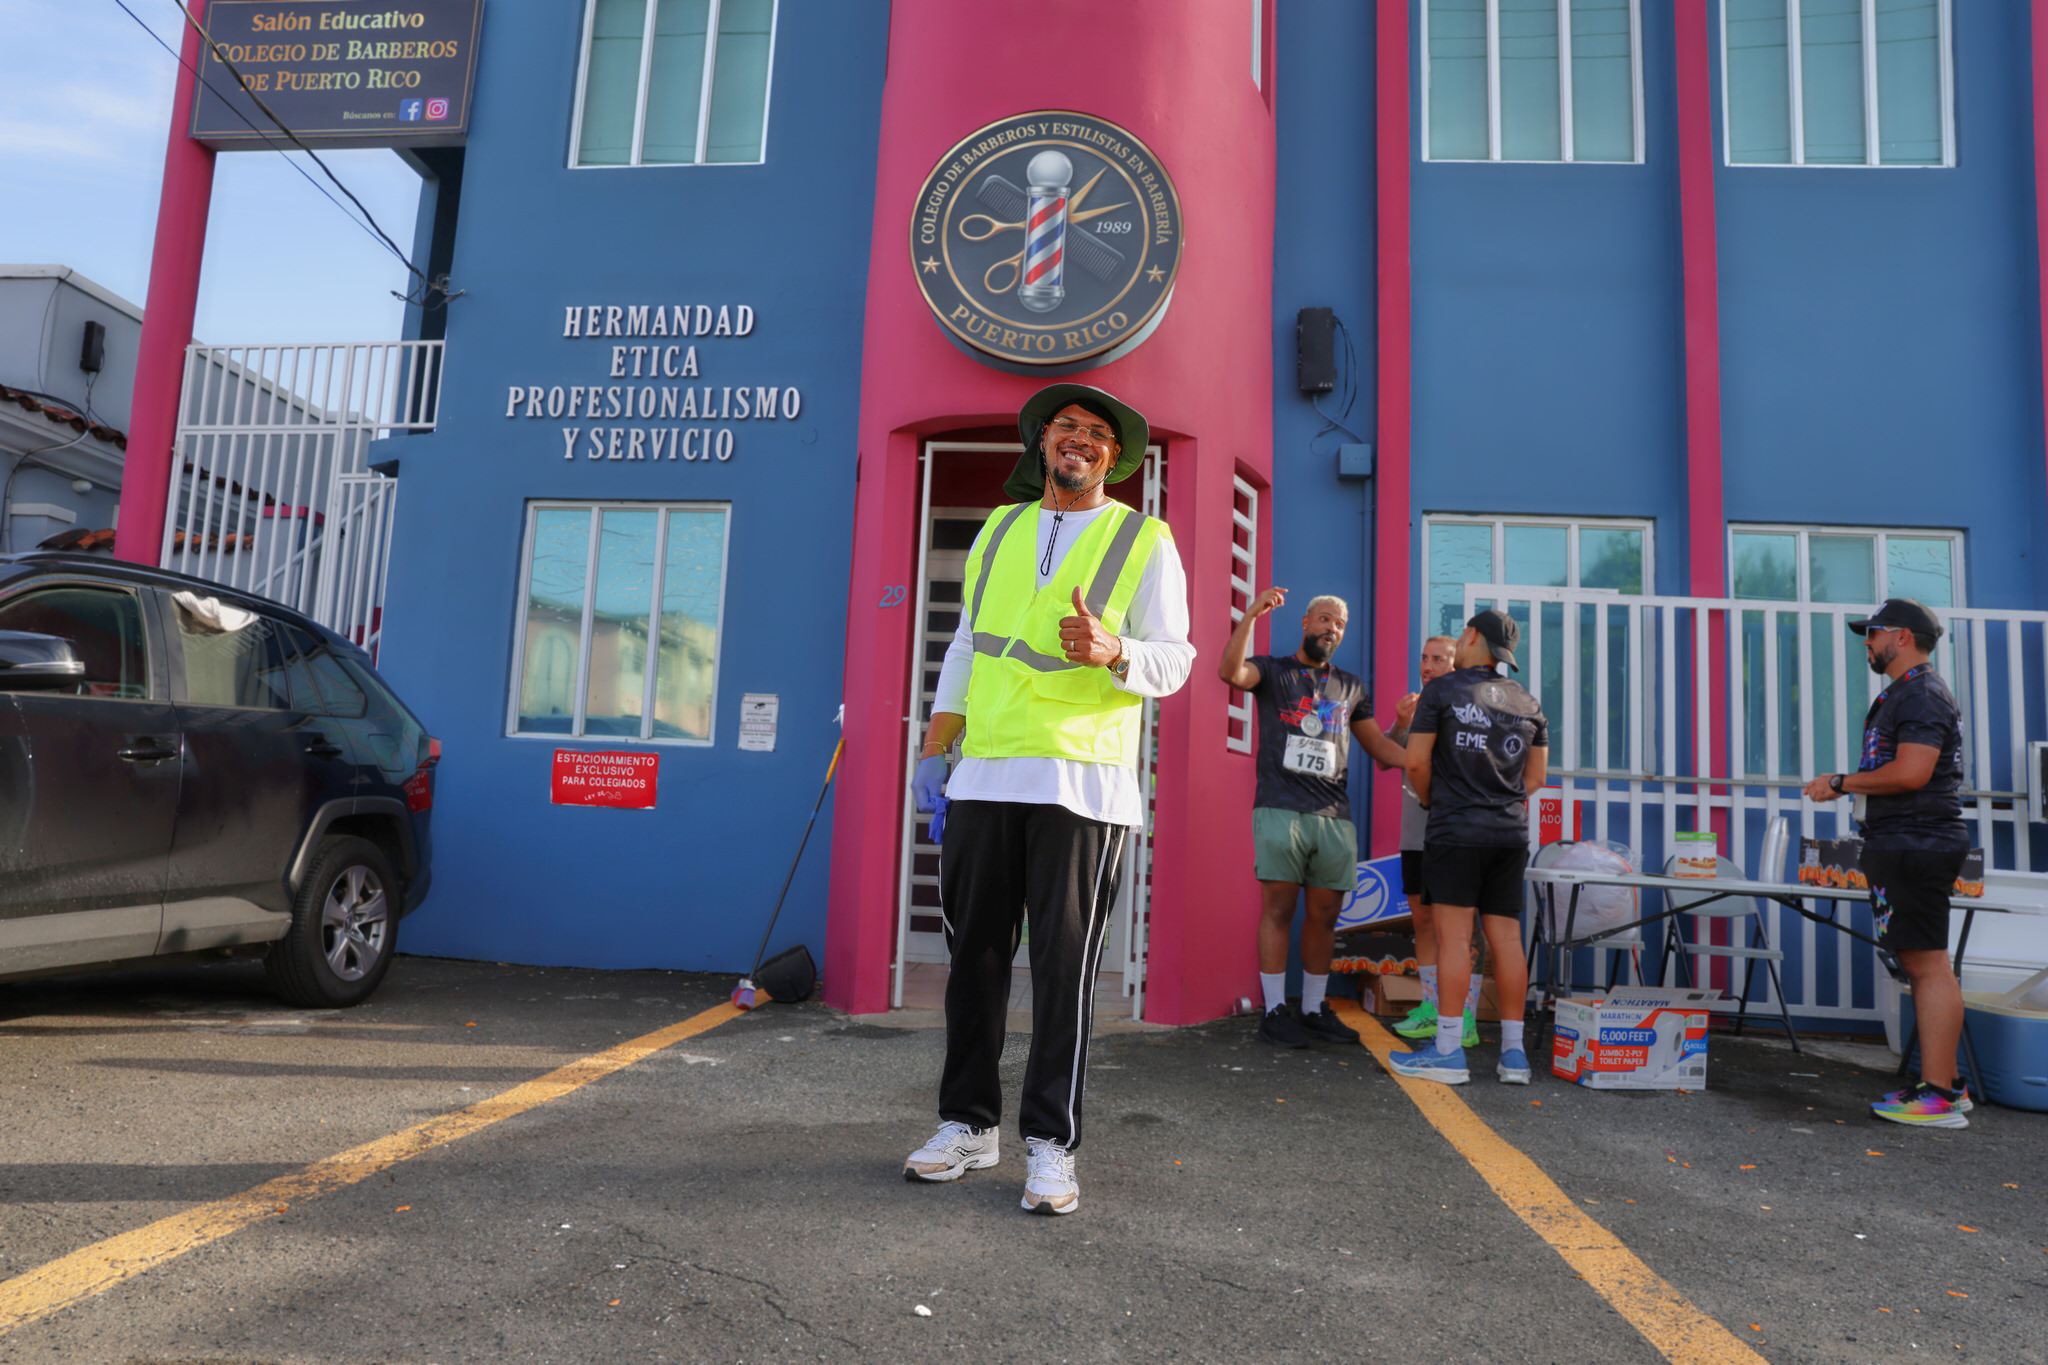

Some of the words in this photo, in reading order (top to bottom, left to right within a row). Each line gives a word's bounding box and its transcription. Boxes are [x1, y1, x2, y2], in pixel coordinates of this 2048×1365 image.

[251, 12, 312, 32] Salón
[319, 11, 425, 31] Educativo
[212, 43, 306, 63] COLEGIO
[311, 43, 340, 61] DE
[346, 40, 458, 60] BARBEROS
[240, 74, 269, 91] DE
[275, 71, 360, 91] PUERTO
[366, 68, 421, 89] RICO
[921, 180, 950, 244] COLEGIO
[945, 161, 965, 182] DE
[962, 124, 1036, 167] BARBEROS
[1038, 122, 1050, 135] Y
[1052, 122, 1131, 159] ESTILISTAS
[1126, 155, 1149, 177] EN
[1141, 173, 1173, 245] BARBERÍA
[1095, 221, 1132, 235] 1989
[563, 305, 755, 337] HERMANDAD
[950, 303, 1056, 353] PUERTO
[1063, 311, 1129, 350] RICO
[609, 345, 699, 378] ETICA
[505, 385, 801, 420] PROFESIONALISMO
[562, 427, 580, 460] Y
[588, 427, 735, 462] SERVICIO
[878, 585, 907, 607] 29
[1455, 731, 1489, 750] EME
[556, 753, 656, 767] ESTACIONAMIENTO
[1296, 752, 1325, 772] 175
[575, 765, 634, 776] EXCLUSIVO
[562, 776, 586, 786] PARA
[589, 777, 646, 789] COLEGIADOS
[1601, 1030, 1627, 1042] 6,000
[1683, 1041, 1690, 1051] 6
[1599, 1049, 1624, 1057] JUMBO
[1599, 1057, 1622, 1065] TOILET
